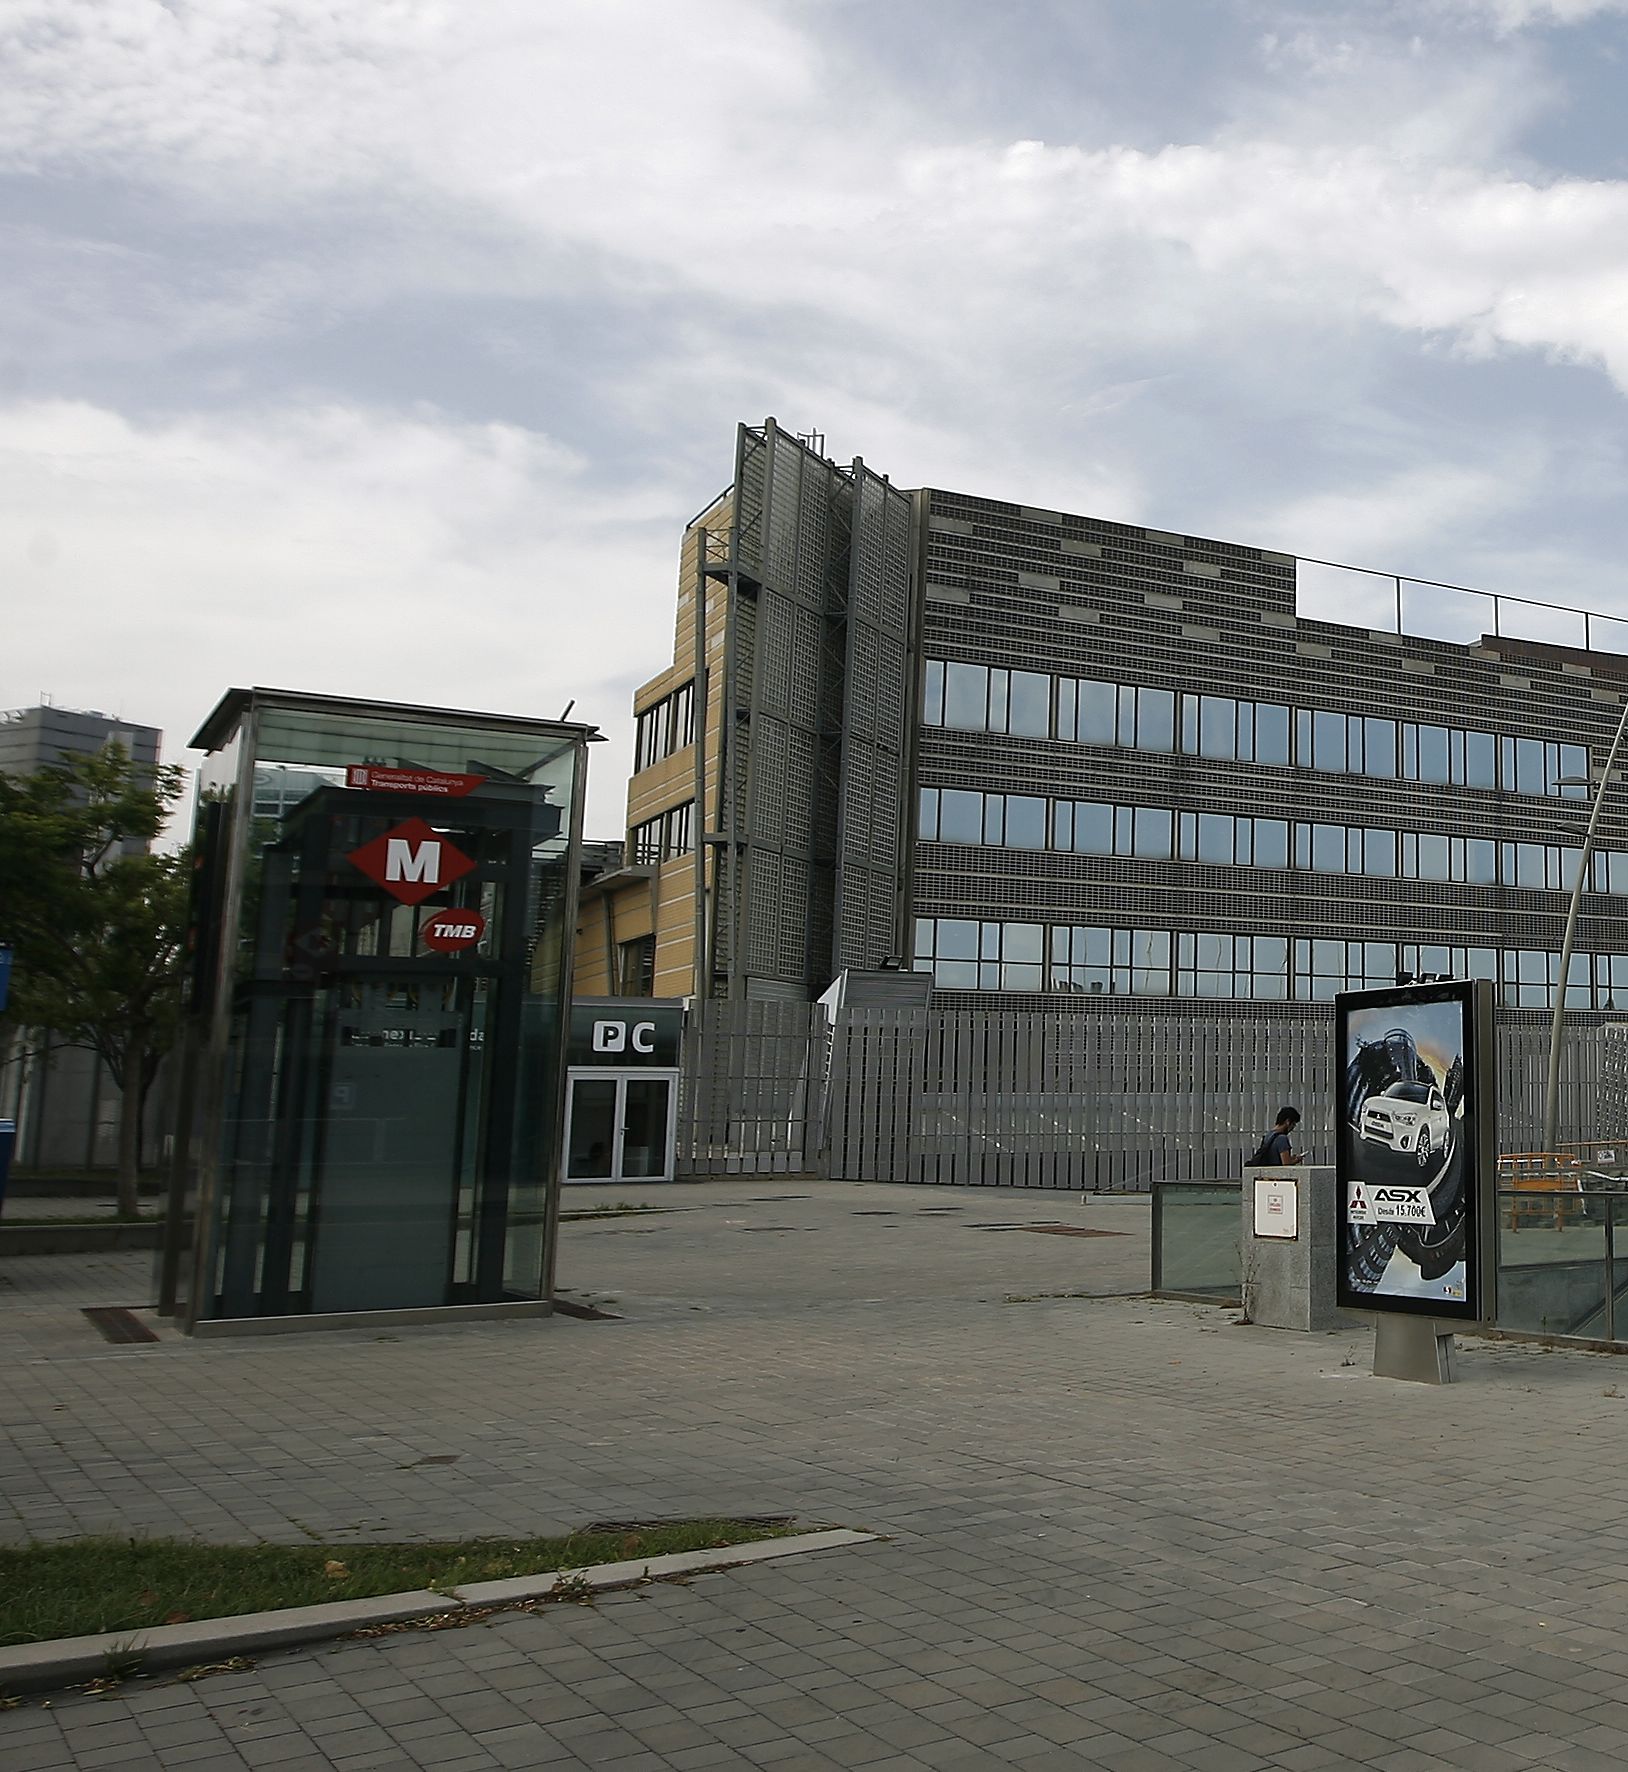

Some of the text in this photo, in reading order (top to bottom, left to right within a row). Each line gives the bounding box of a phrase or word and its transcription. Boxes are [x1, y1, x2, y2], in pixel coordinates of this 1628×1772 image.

[371, 779, 416, 792] Transports
[426, 775, 464, 787] Catalunya
[385, 838, 441, 884] M
[433, 923, 477, 939] TMB
[631, 1021, 656, 1053] C
[1374, 1188, 1423, 1203] ASX
